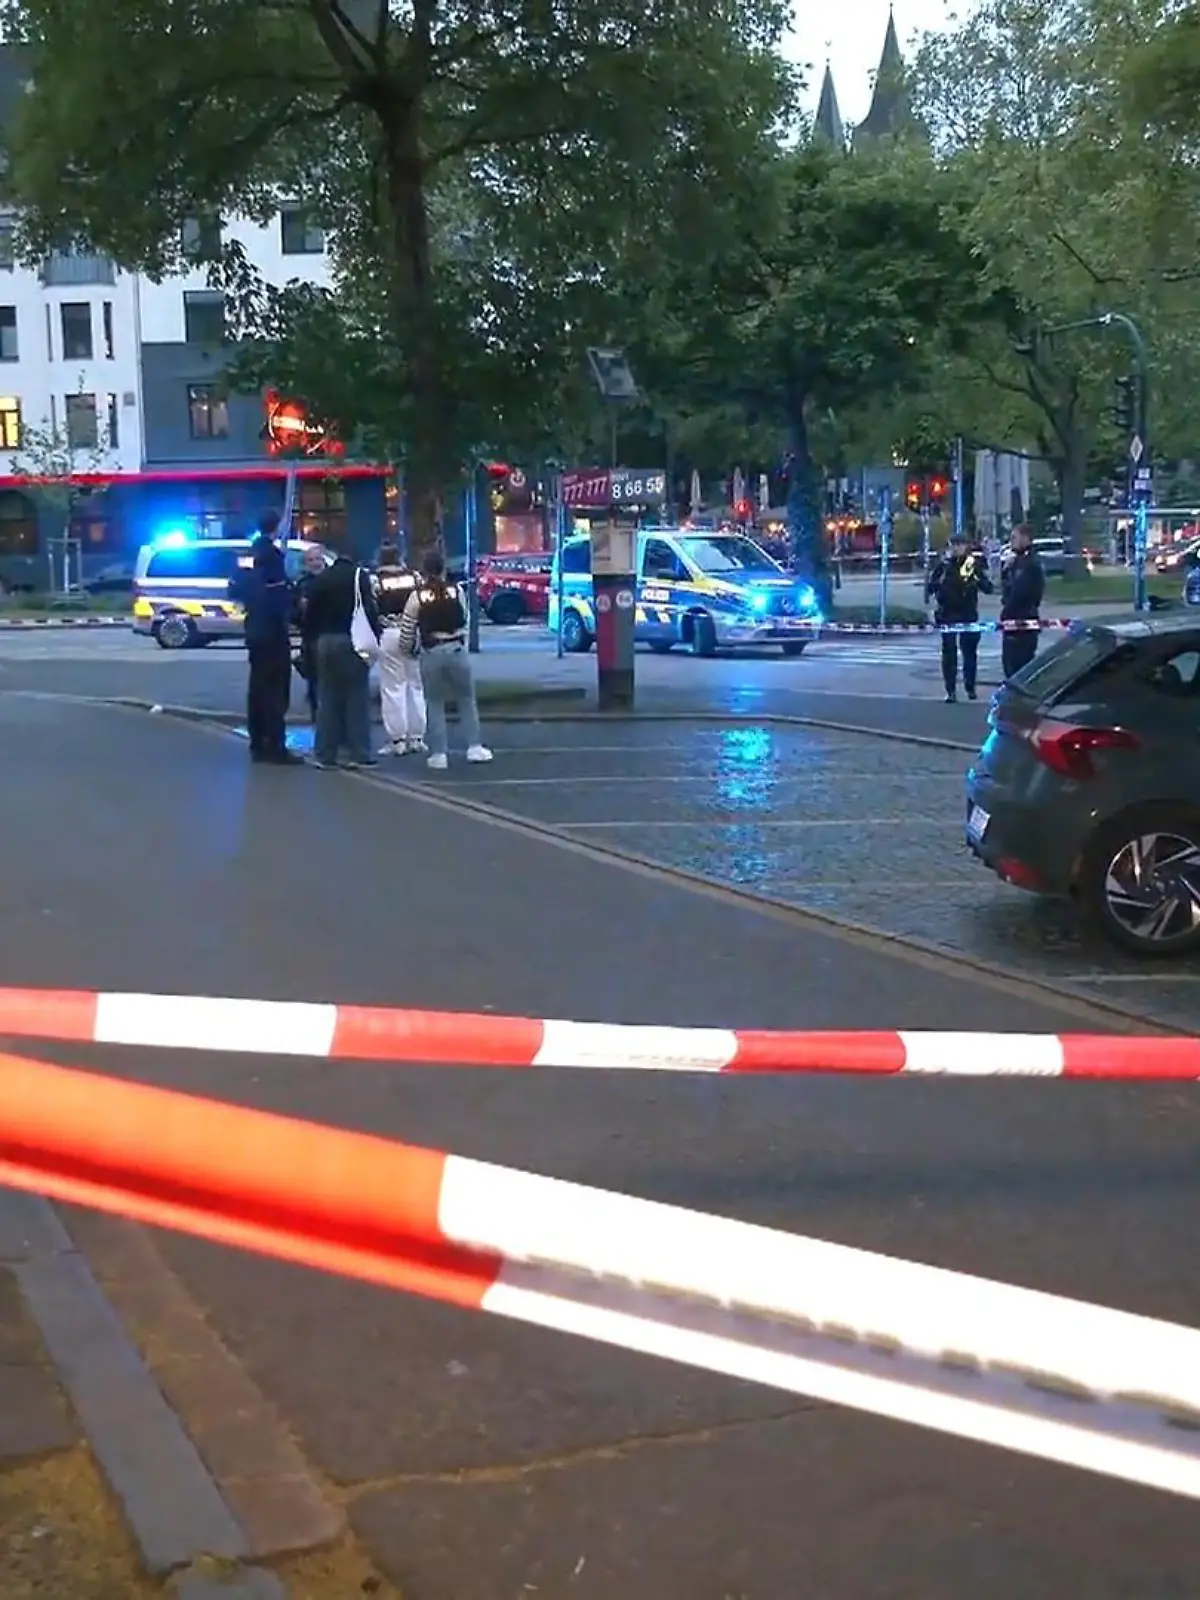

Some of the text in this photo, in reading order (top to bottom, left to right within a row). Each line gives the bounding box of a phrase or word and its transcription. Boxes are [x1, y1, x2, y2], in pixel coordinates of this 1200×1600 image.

[564, 482, 584, 502] 777
[587, 476, 607, 497] 777
[612, 484, 621, 499] 8
[625, 479, 642, 496] 66
